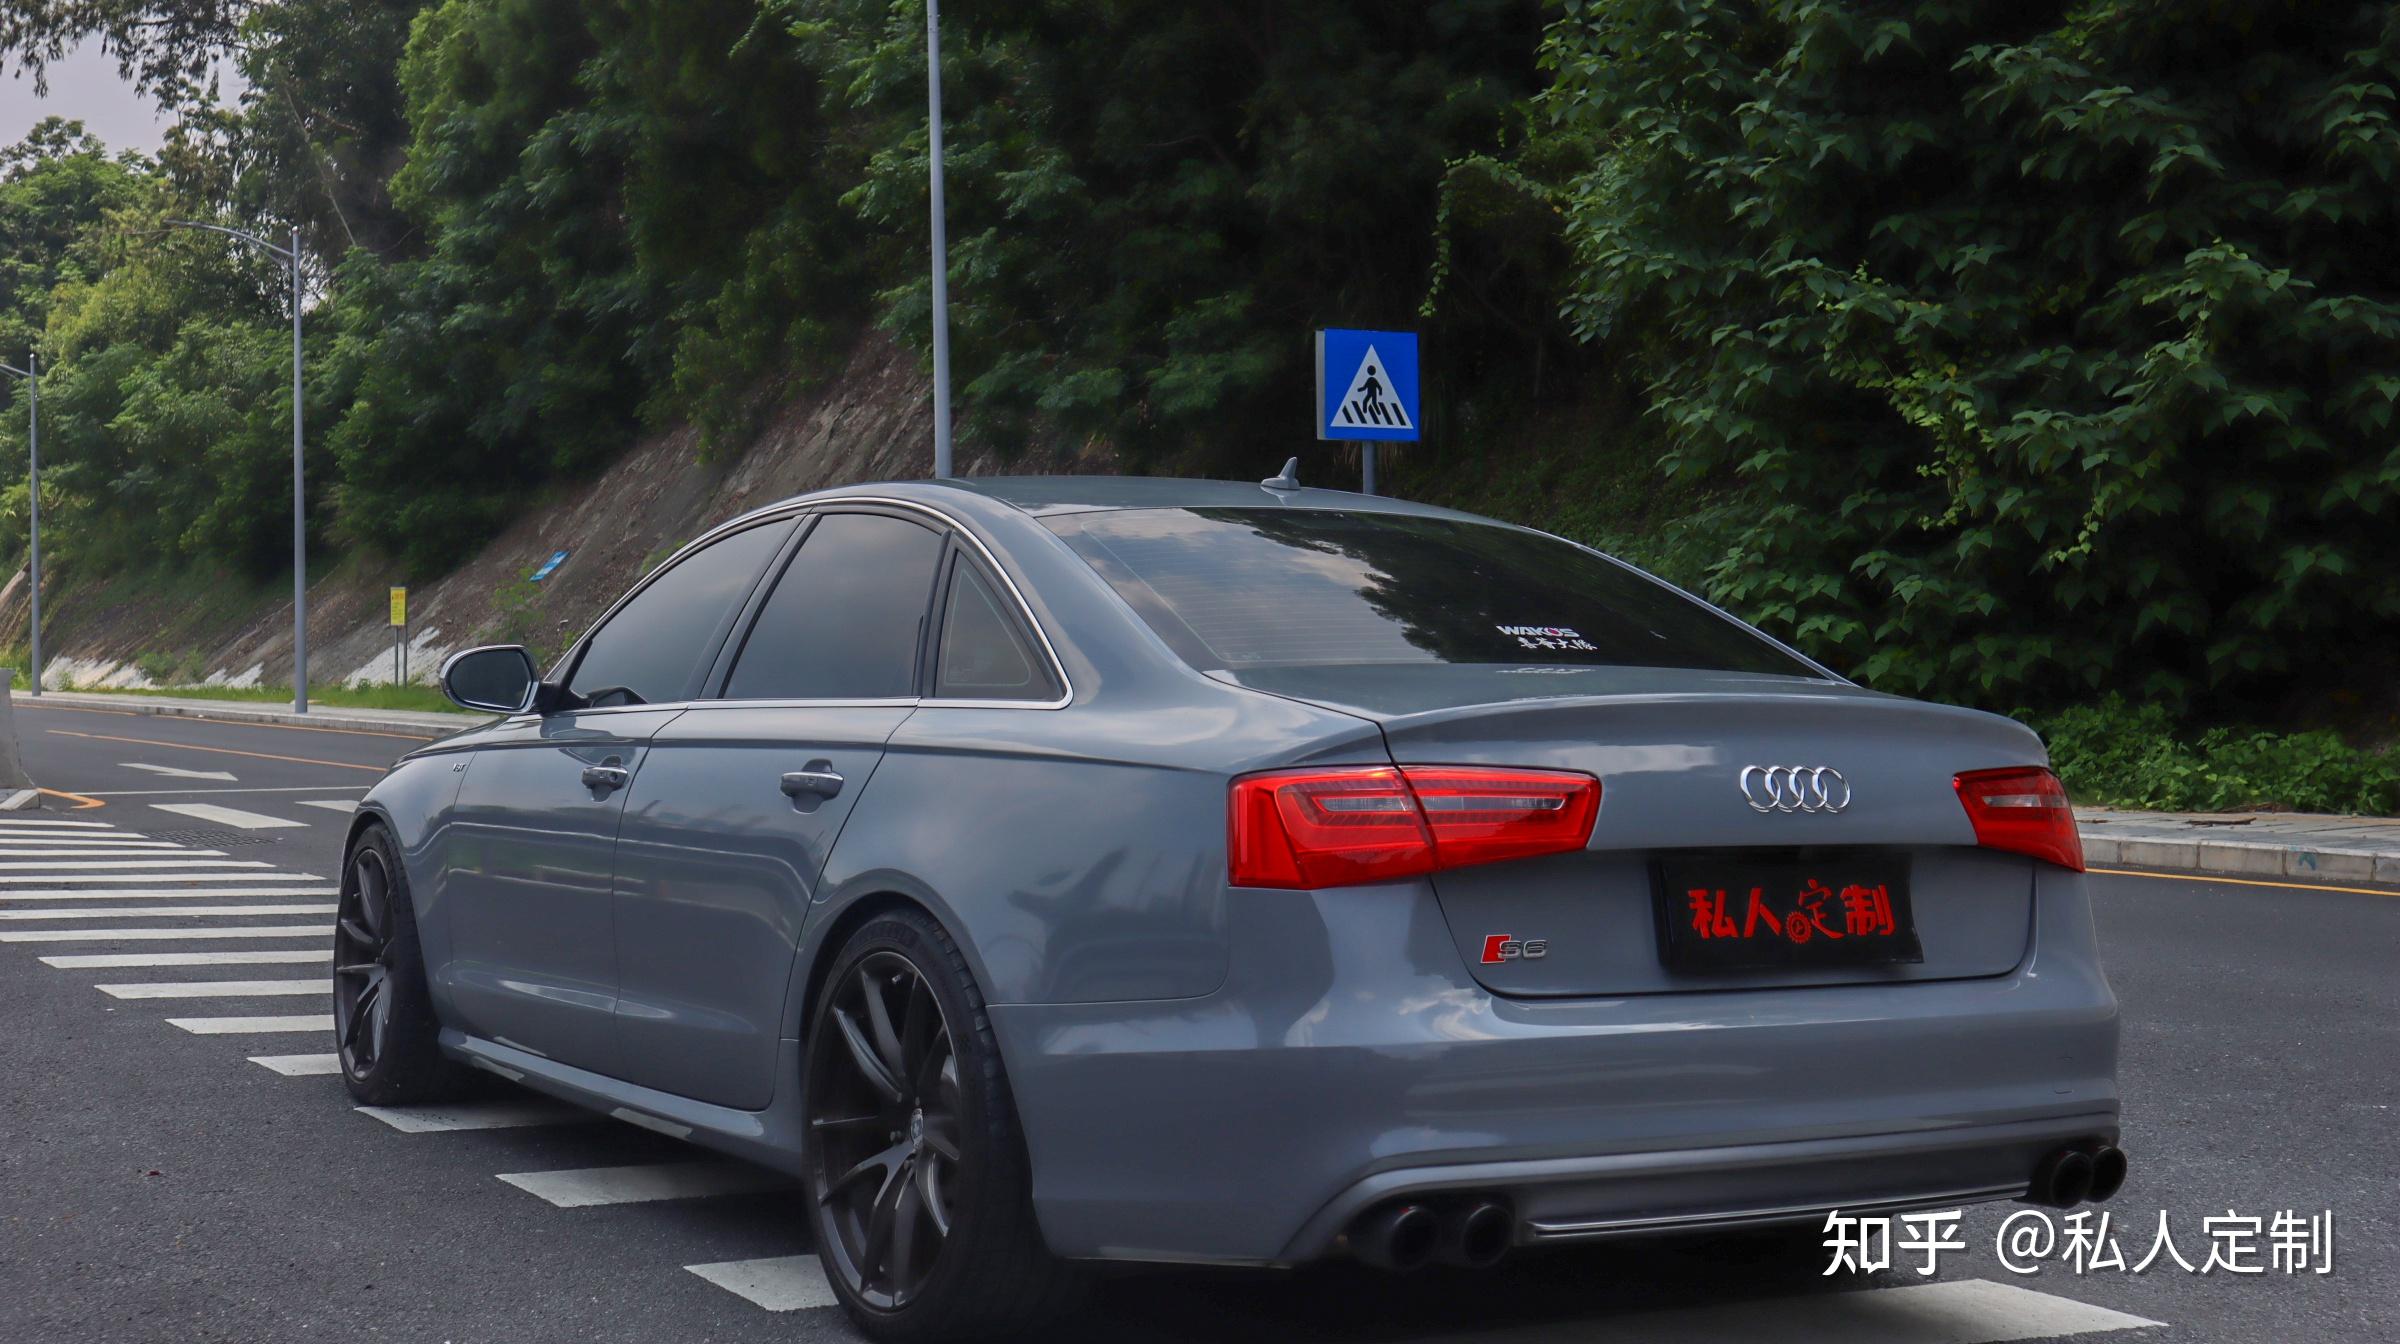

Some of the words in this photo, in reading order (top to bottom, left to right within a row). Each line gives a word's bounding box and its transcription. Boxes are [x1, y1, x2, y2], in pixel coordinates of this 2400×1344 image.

[1688, 879, 1896, 943] 私人定制
[1497, 939, 1547, 959] S6
